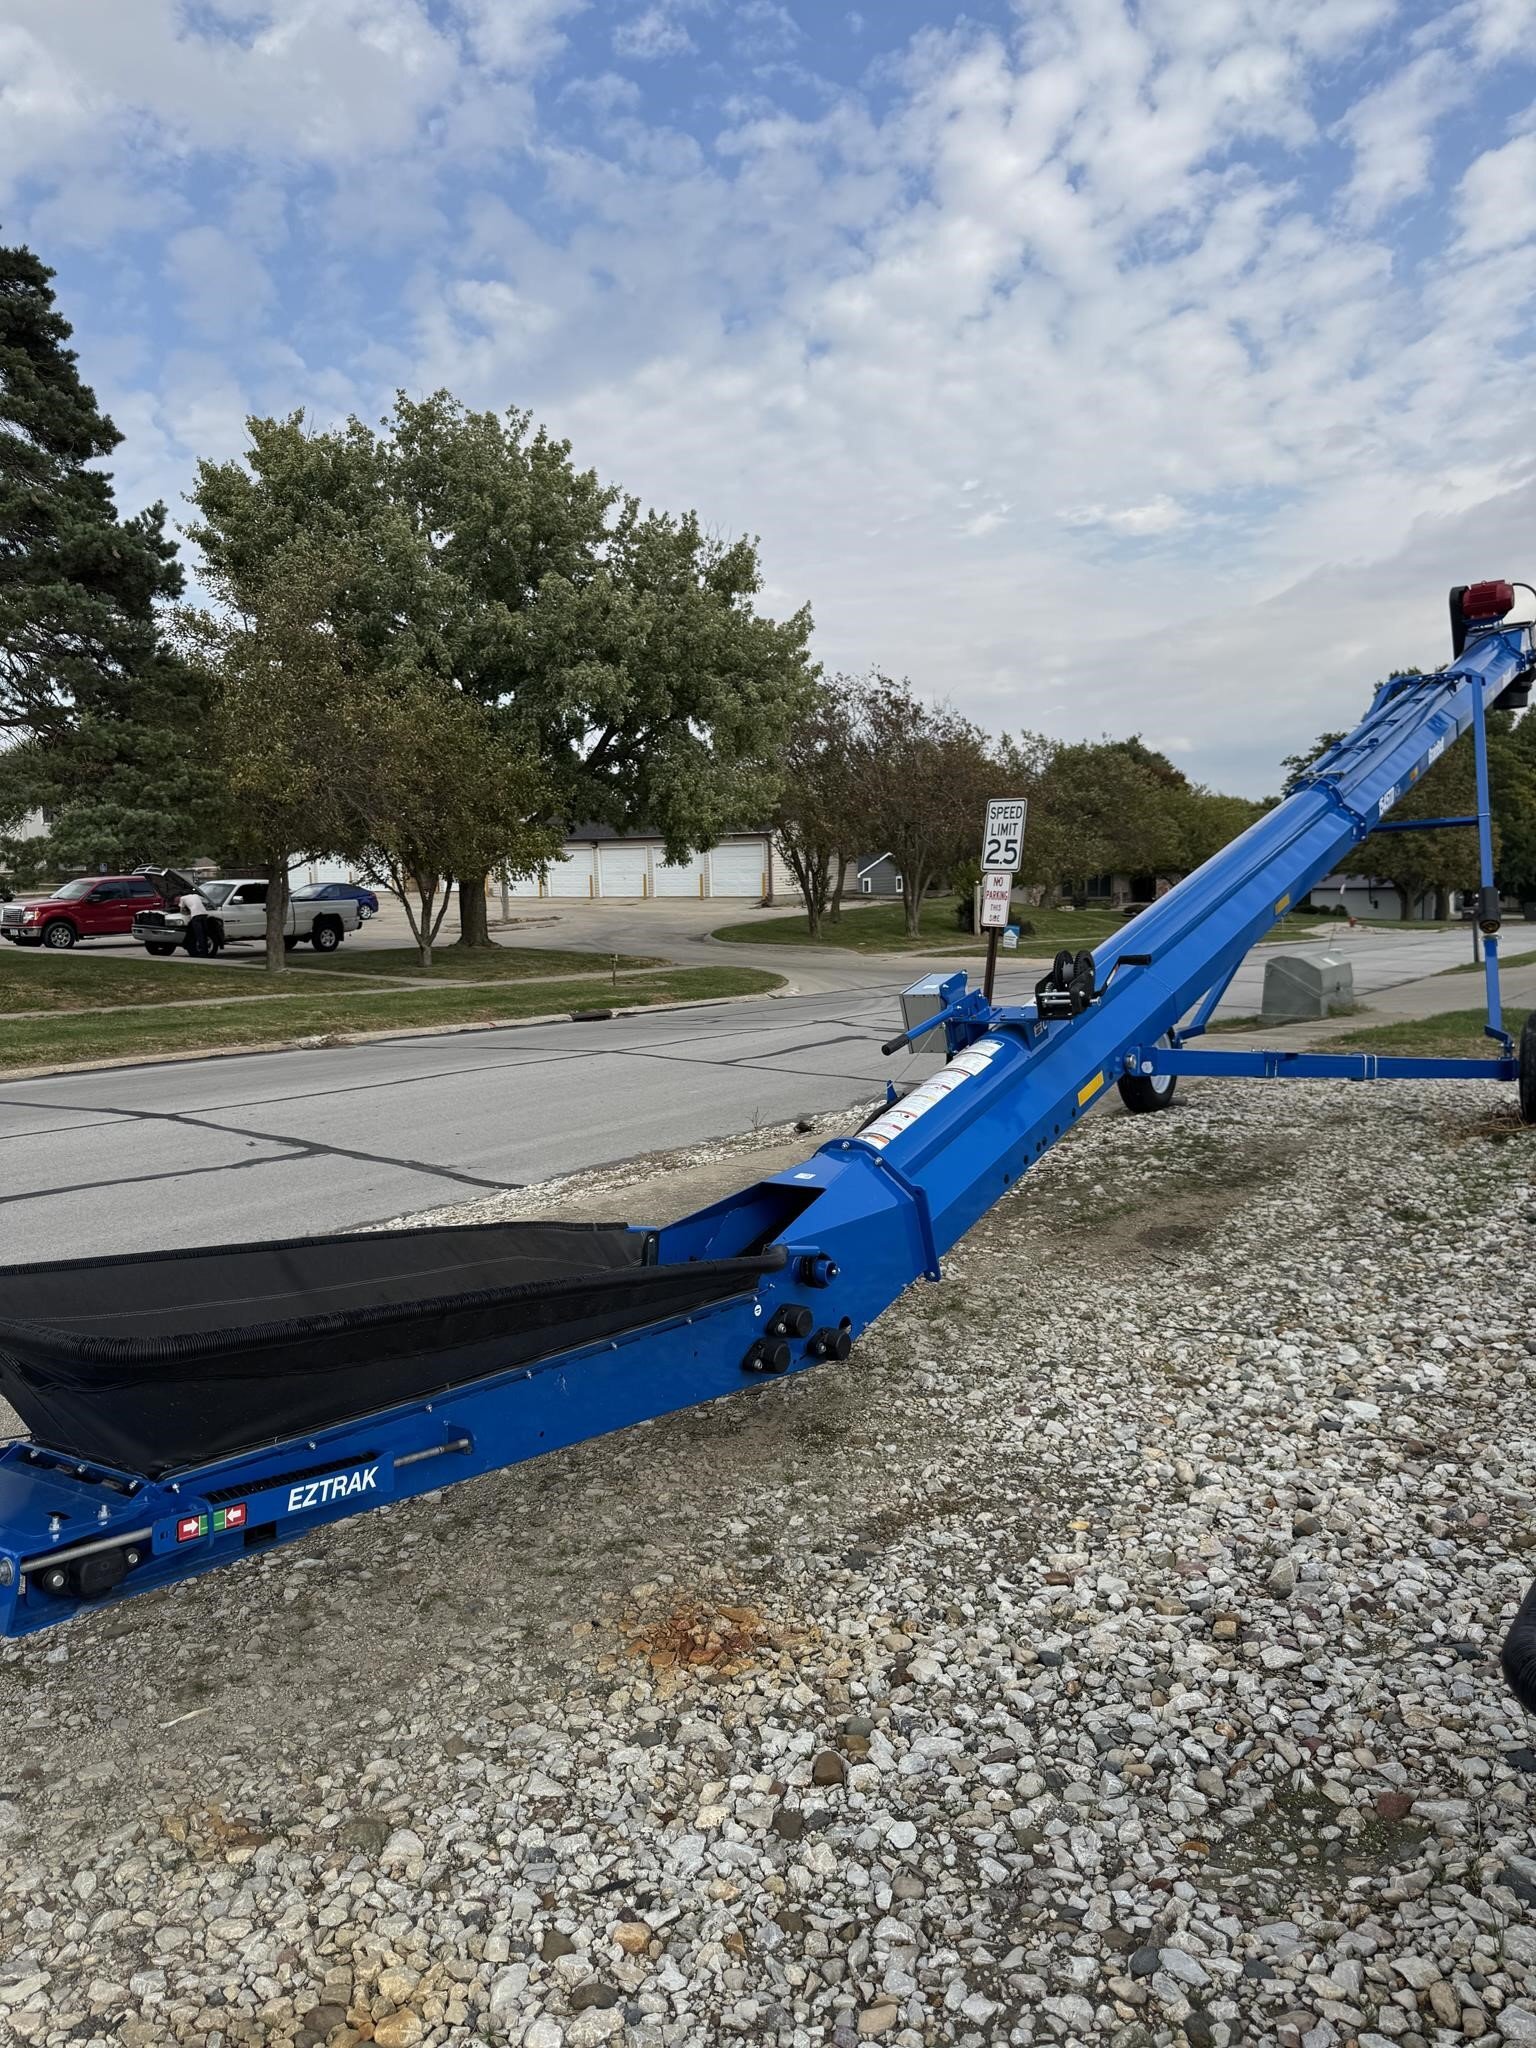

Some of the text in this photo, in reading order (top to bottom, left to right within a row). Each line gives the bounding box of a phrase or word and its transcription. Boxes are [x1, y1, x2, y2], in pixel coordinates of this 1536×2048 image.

[990, 806, 1023, 820] SPEED
[991, 822, 1019, 836] LIMIT
[985, 838, 1018, 865] 25
[993, 877, 1003, 887] NO
[986, 890, 1009, 901] PARKING
[288, 1466, 379, 1512] EZTRAK
